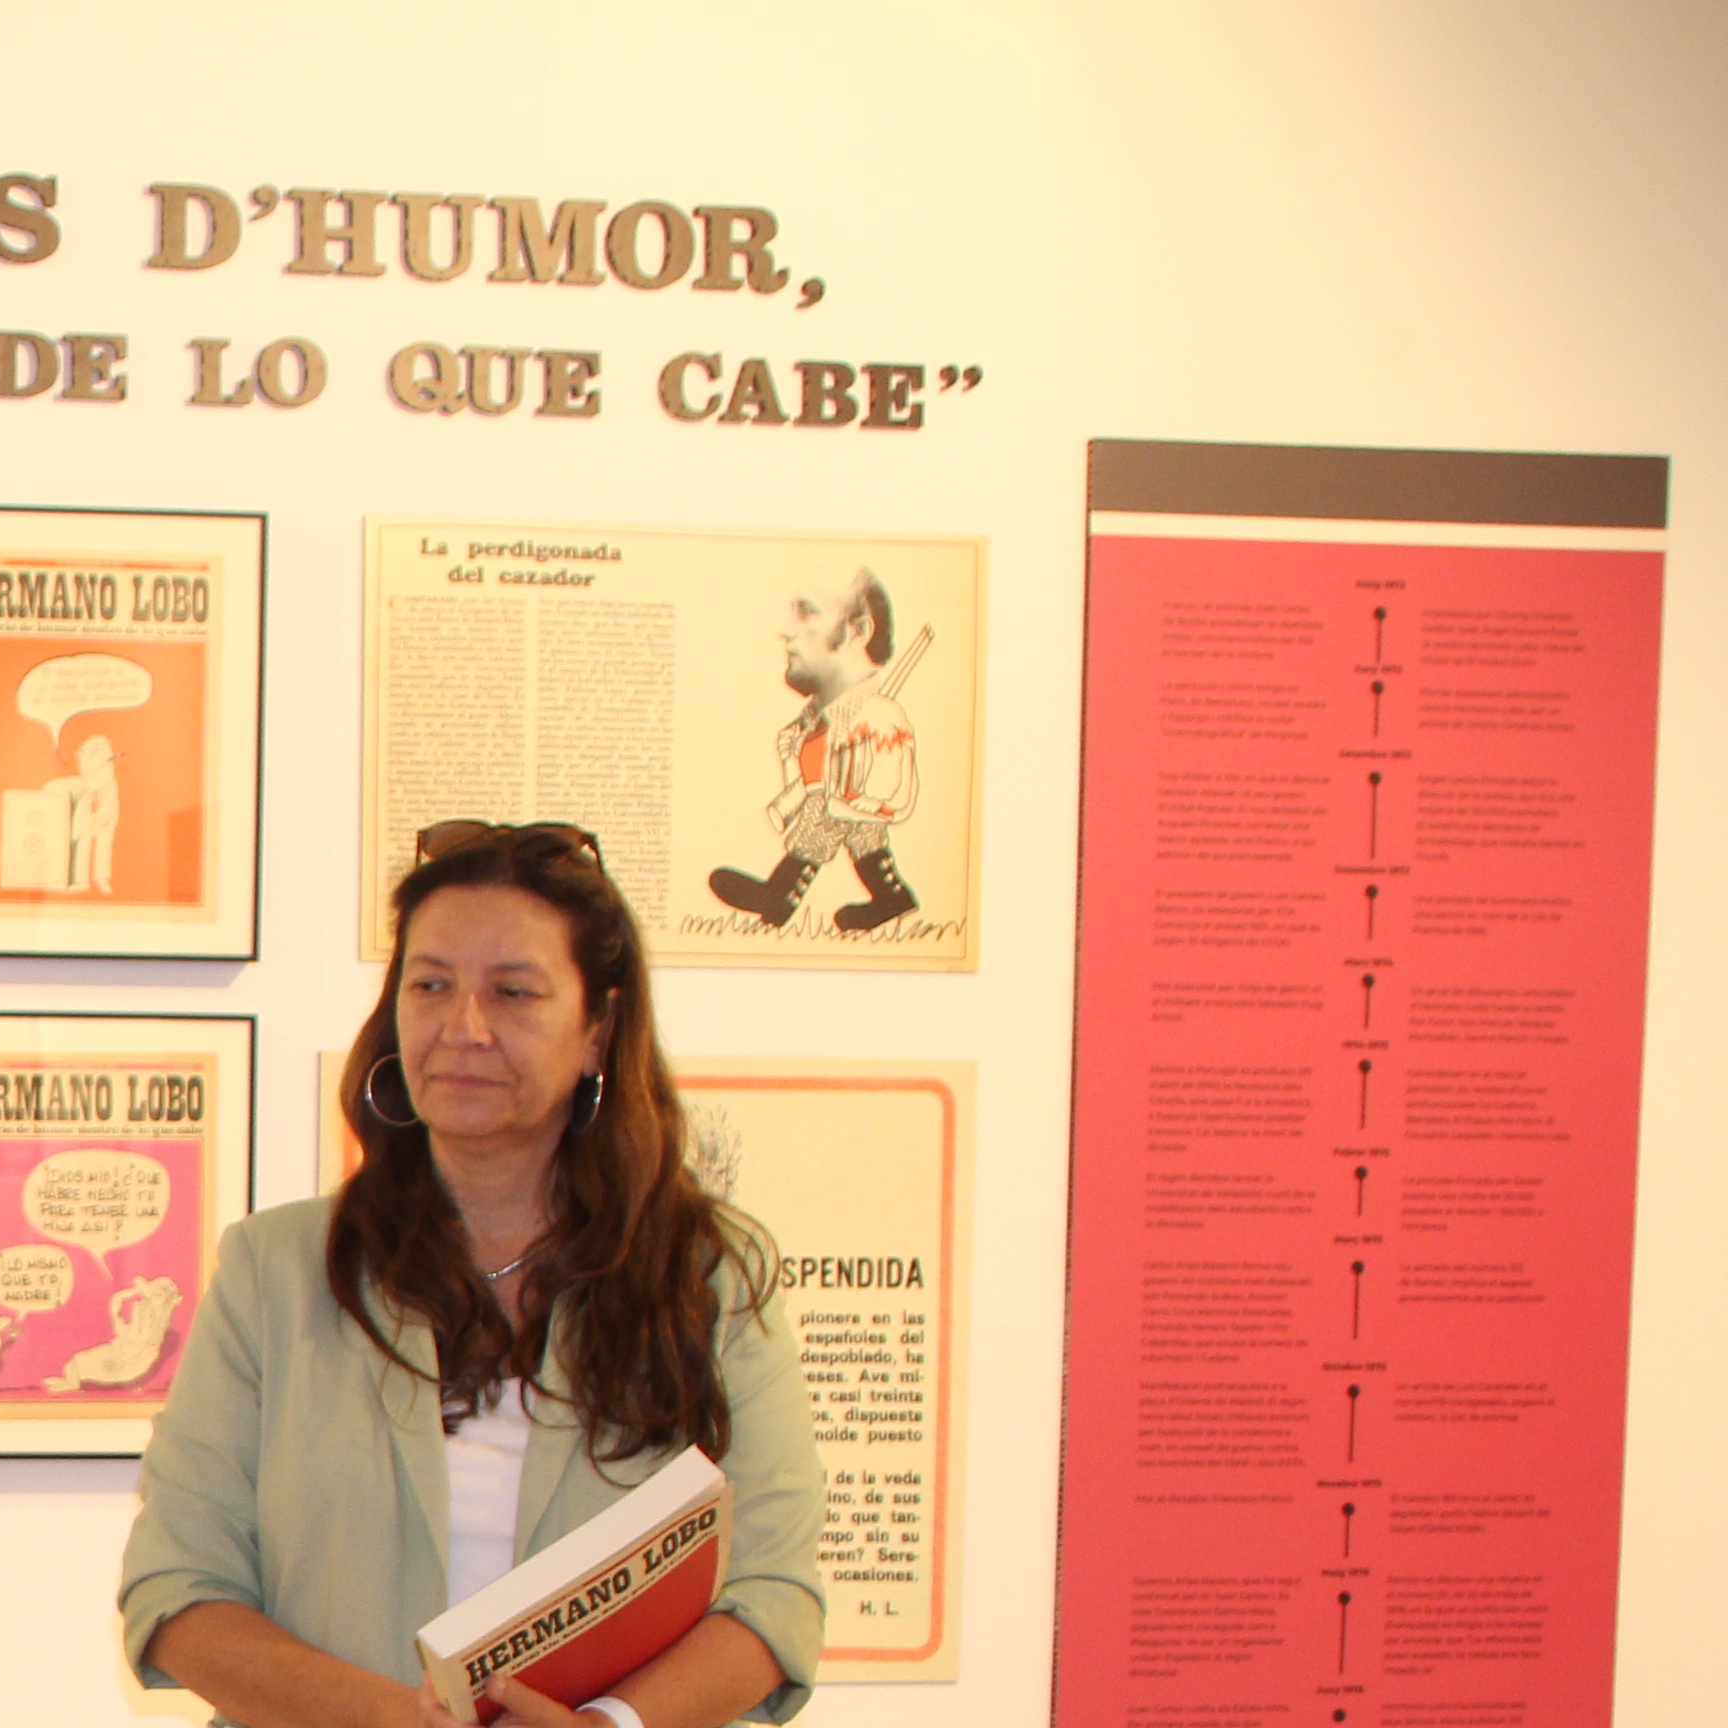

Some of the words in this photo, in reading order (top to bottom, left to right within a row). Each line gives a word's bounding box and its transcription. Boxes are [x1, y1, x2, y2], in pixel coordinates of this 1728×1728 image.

[147, 184, 825, 310] D'HUMOR,
[190, 338, 326, 409] LO
[387, 343, 600, 419] QUE
[420, 537, 449, 556] La
[468, 540, 622, 564] perdigonada
[447, 564, 485, 584] del
[498, 568, 596, 587] cazador
[132, 574, 209, 622] LOBO
[127, 1075, 204, 1121] LOBO
[1, 1273, 33, 1286] QUE
[781, 1259, 924, 1289] SPENDIDA
[799, 1312, 860, 1328] pionera
[871, 1314, 890, 1326] en
[902, 1310, 924, 1326] las
[805, 1331, 886, 1347] españoles
[900, 1329, 924, 1346] del
[799, 1348, 896, 1368] despoblado,
[905, 1349, 924, 1366] ha
[858, 1369, 889, 1384] Ave
[829, 1388, 861, 1404] casi
[869, 1389, 923, 1404] treinta
[844, 1407, 922, 1426] dispuesta
[867, 1429, 922, 1446] puesto
[835, 1469, 854, 1486] de
[862, 1469, 875, 1486] la
[884, 1469, 921, 1486] veda
[864, 1489, 883, 1504] de
[892, 1494, 920, 1505] sus
[851, 1513, 879, 1527] que
[865, 1528, 889, 1544] sin
[901, 1532, 919, 1544] su
[833, 1569, 918, 1583] ocasiones.
[465, 1566, 632, 1687] HERMANO
[642, 1507, 717, 1575] LOBO
[858, 1601, 877, 1615] H.
[884, 1601, 900, 1615] L.
